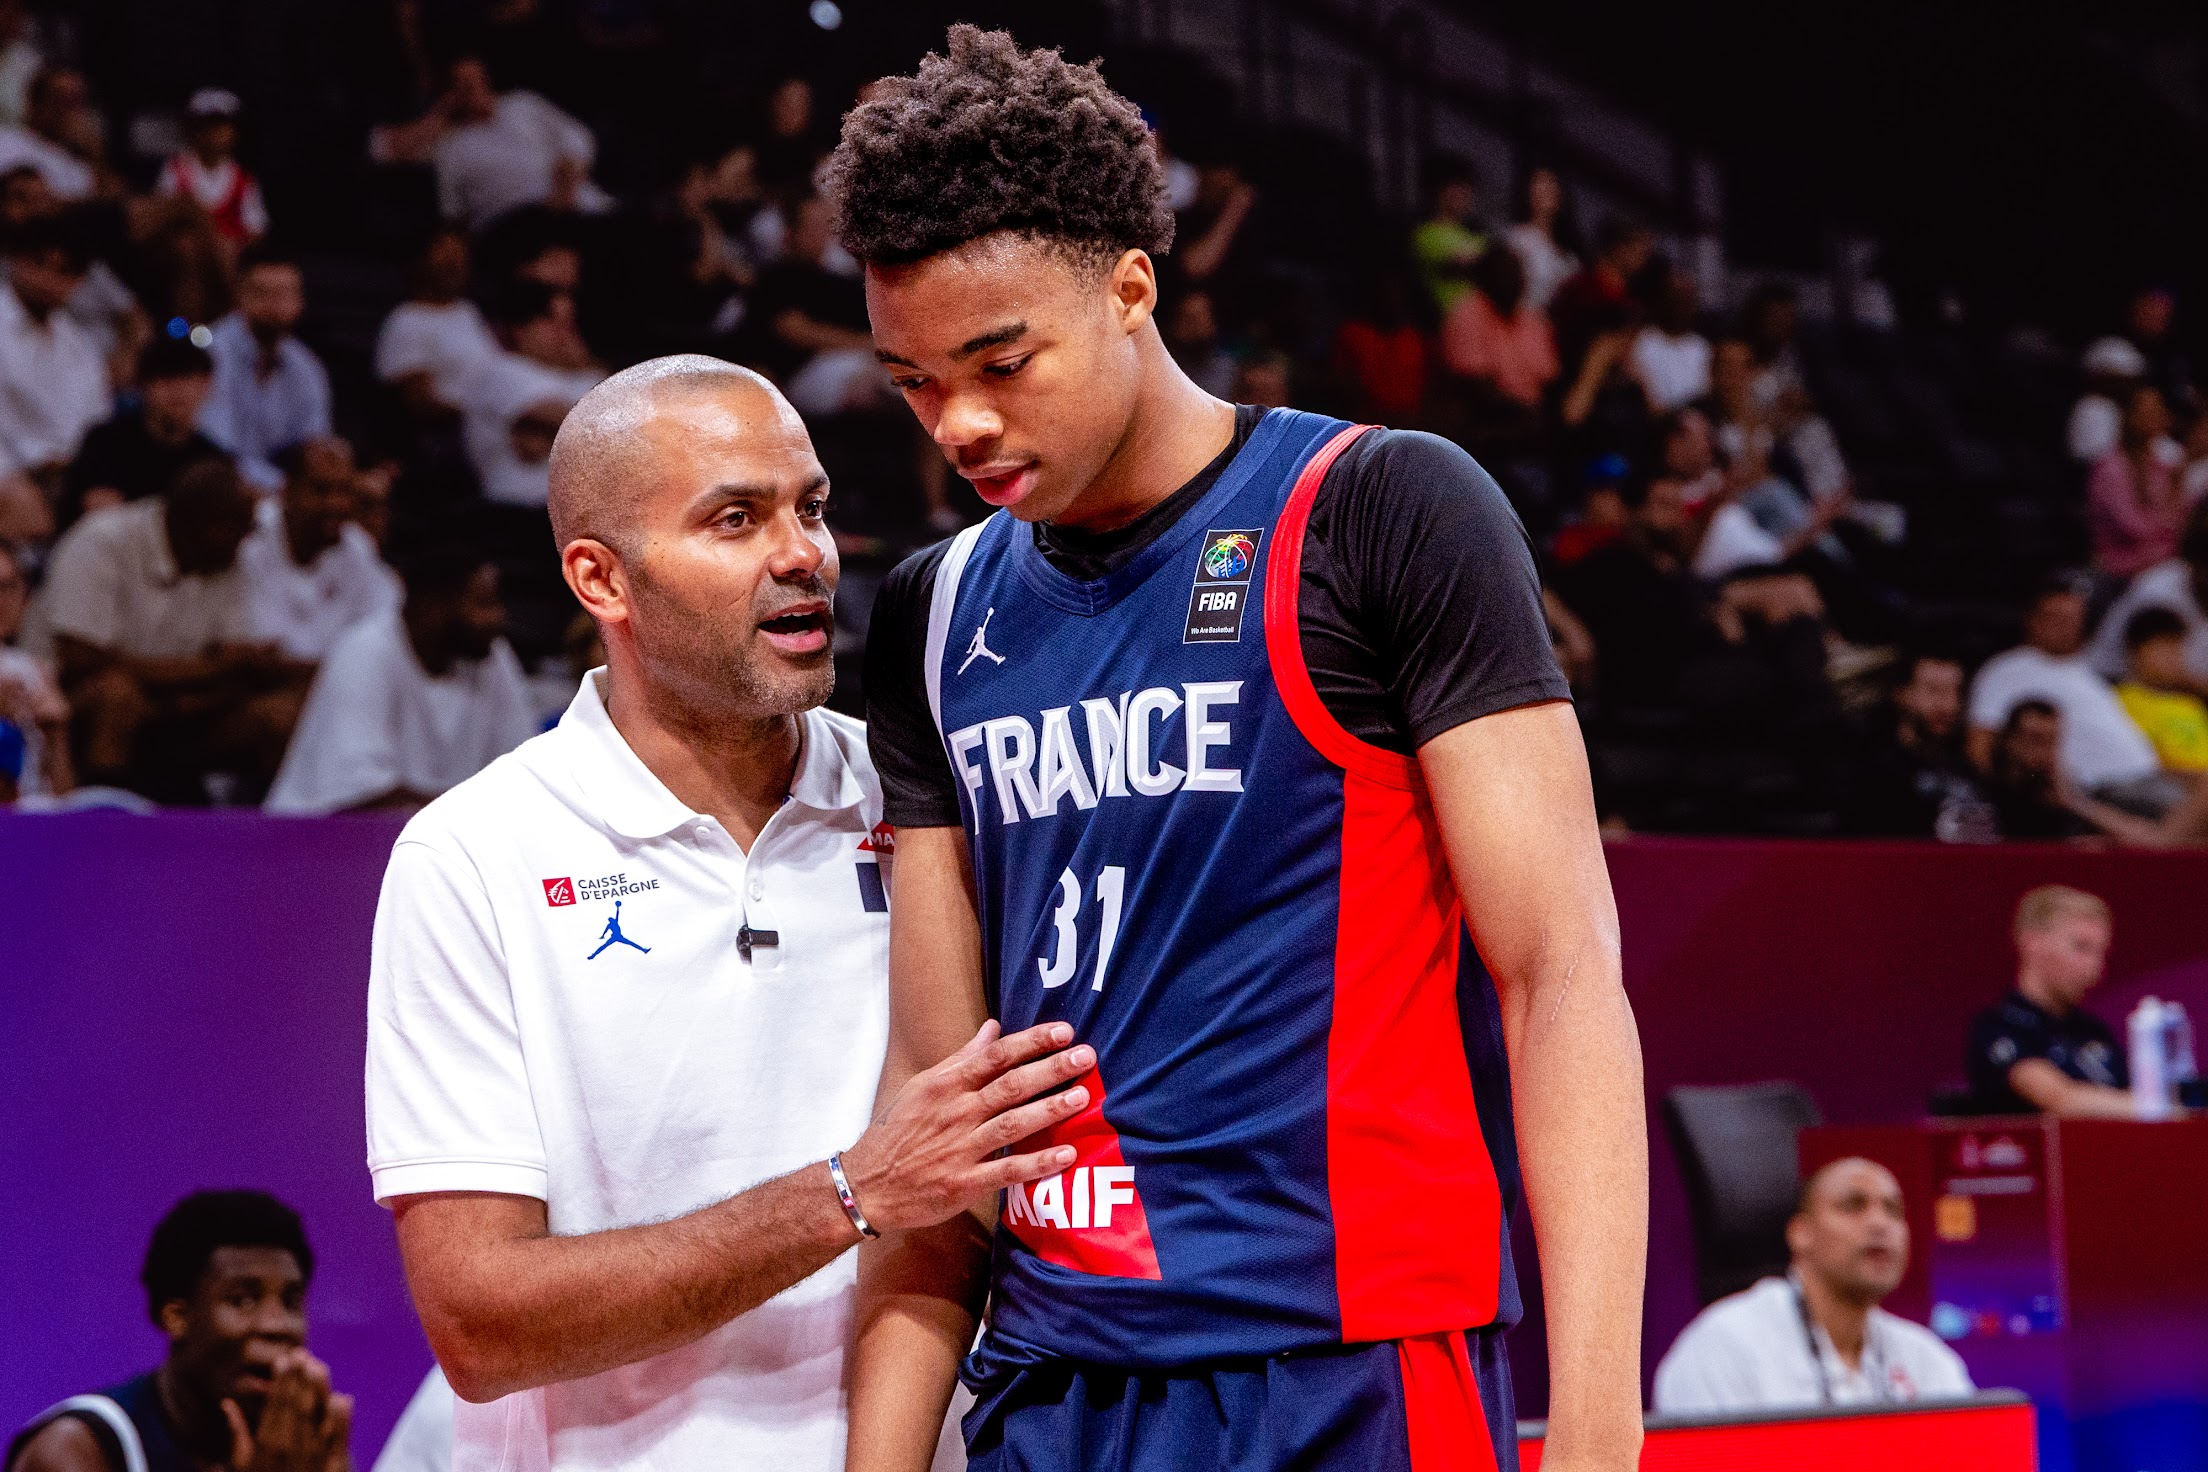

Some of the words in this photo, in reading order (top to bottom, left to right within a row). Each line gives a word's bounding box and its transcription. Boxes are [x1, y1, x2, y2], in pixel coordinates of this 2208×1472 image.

[1198, 592, 1237, 611] FIBA
[1191, 627, 1199, 635] We
[1208, 626, 1235, 634] Basketball
[948, 680, 1245, 836] FRANCE
[867, 832, 895, 846] MA
[578, 873, 628, 889] CAISSE
[581, 879, 660, 901] D'EPARGNE
[1038, 865, 1126, 991] 31
[1007, 1166, 1136, 1229] MAIF
